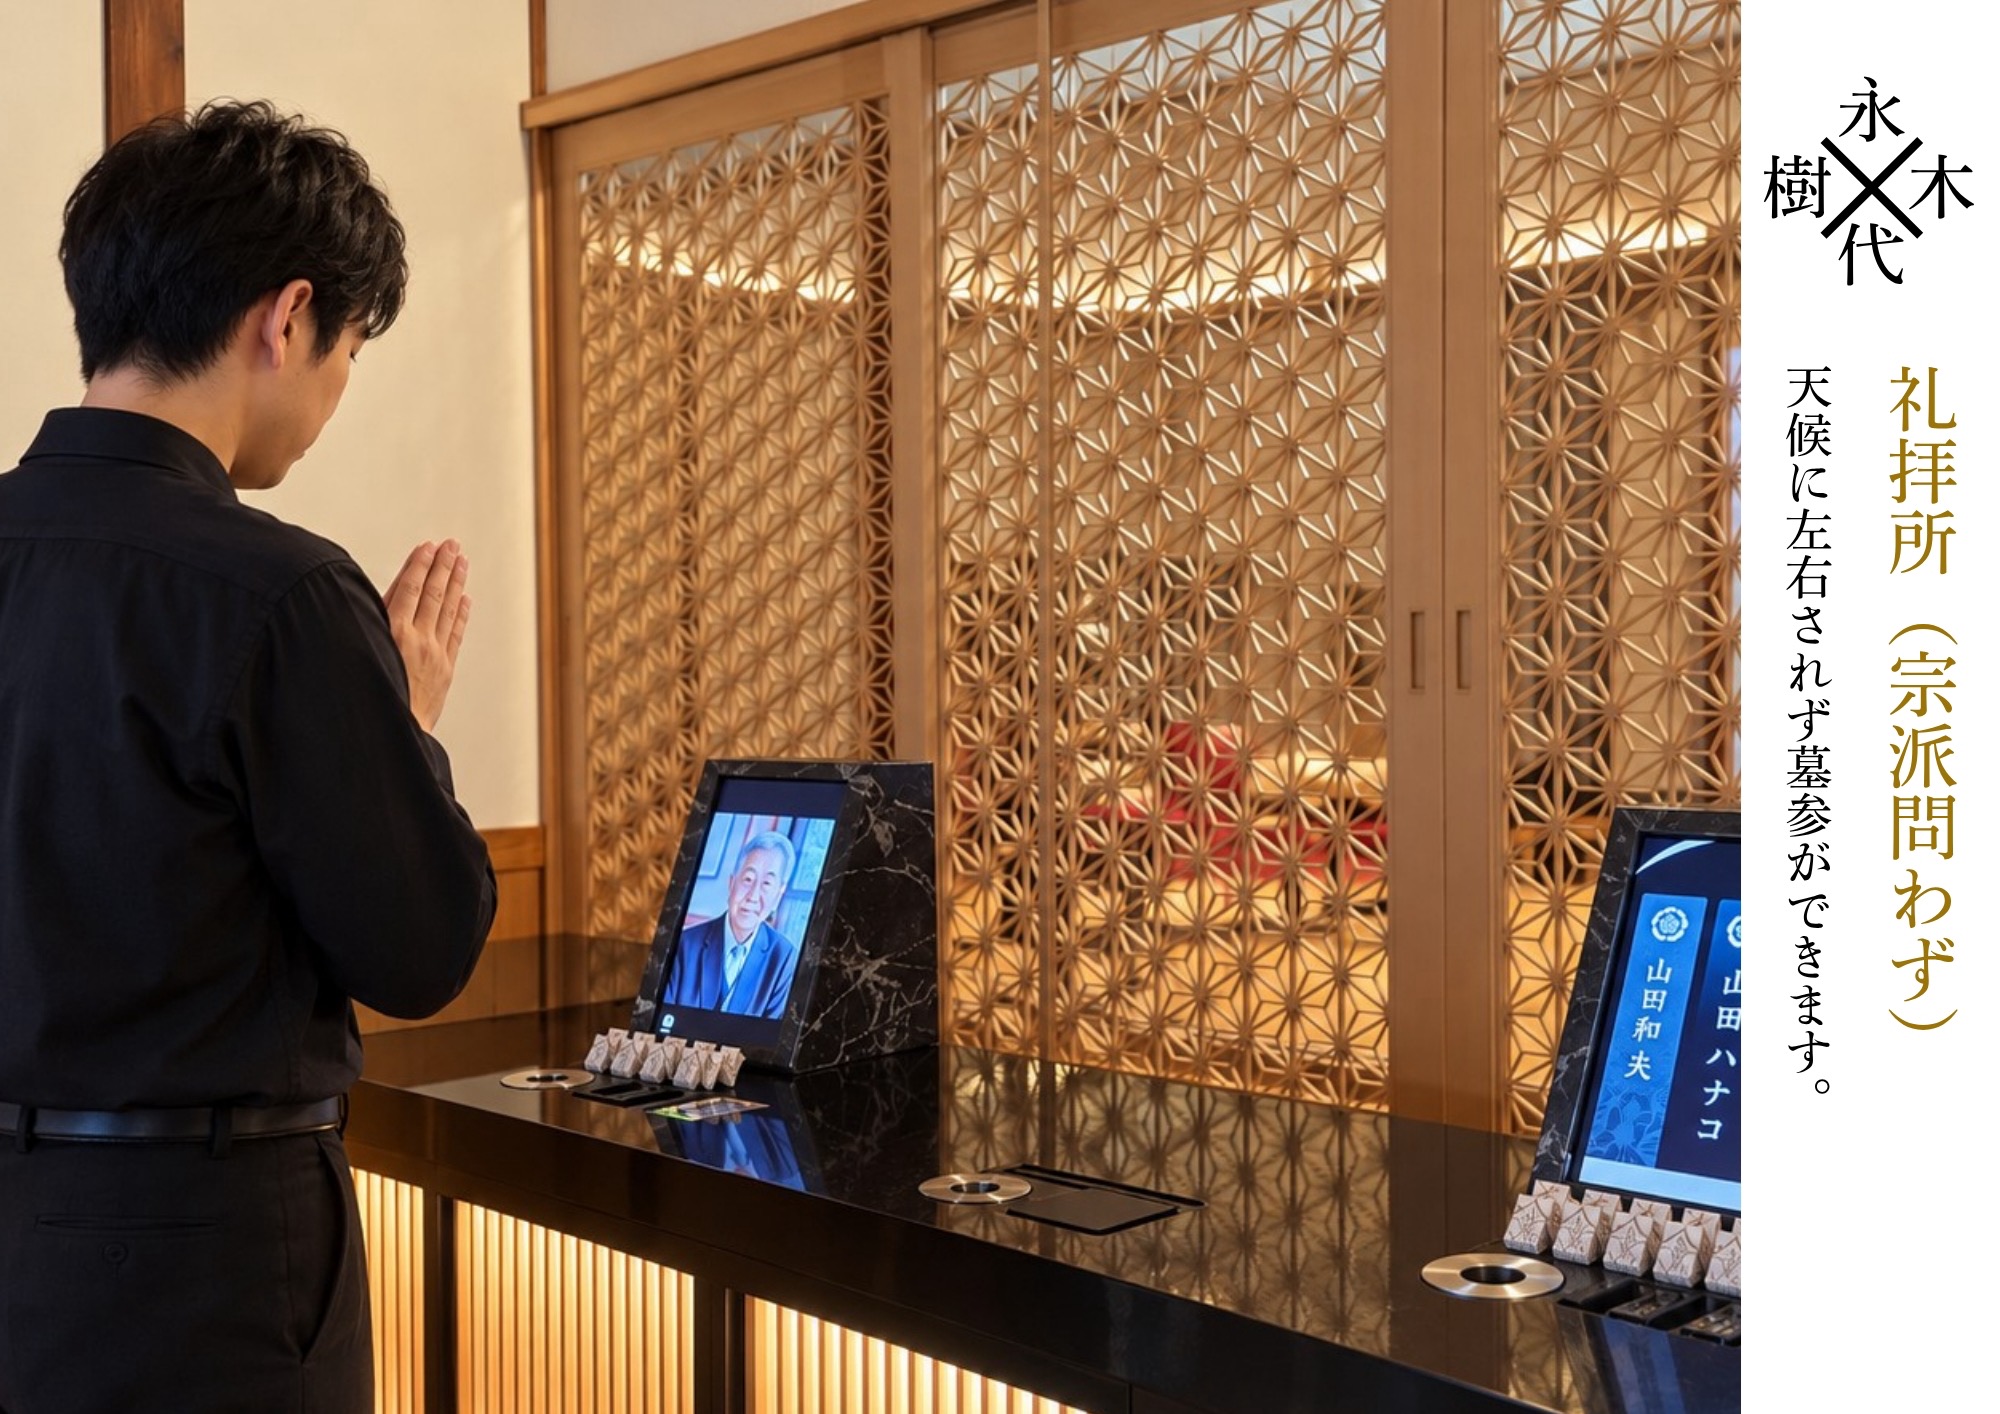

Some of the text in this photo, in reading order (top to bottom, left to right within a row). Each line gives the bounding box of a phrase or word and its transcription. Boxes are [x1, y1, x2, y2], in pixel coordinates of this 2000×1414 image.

[1624, 958, 1673, 1081] 山田和夫
[1697, 969, 1741, 1140] 山田ハナコ
